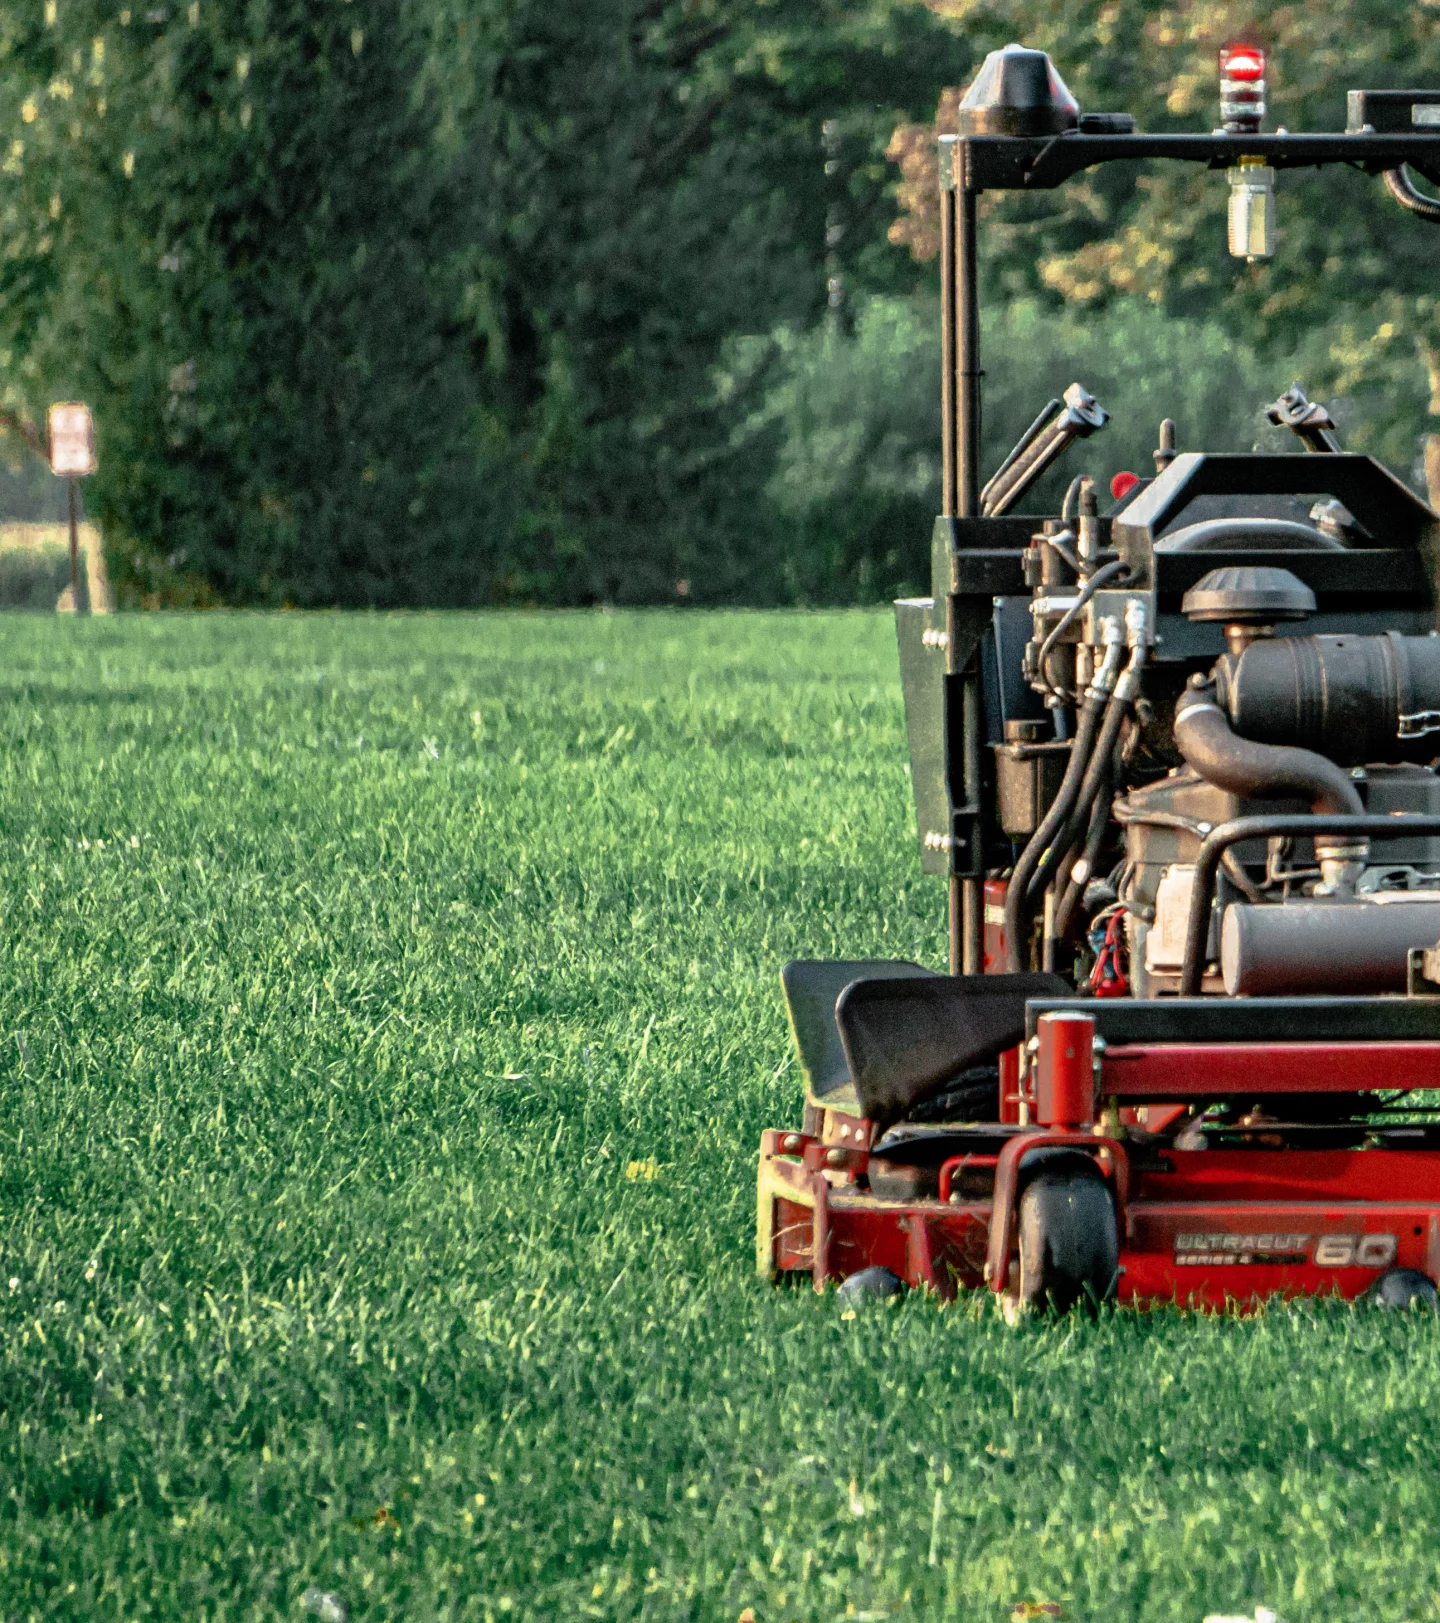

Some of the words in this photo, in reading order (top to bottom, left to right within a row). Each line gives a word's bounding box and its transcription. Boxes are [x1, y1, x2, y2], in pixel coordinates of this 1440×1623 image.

[1176, 1234, 1310, 1250] ULTRACUT
[1315, 1235, 1398, 1266] 60
[1176, 1254, 1235, 1265] SERIES
[1239, 1254, 1251, 1265] 4
